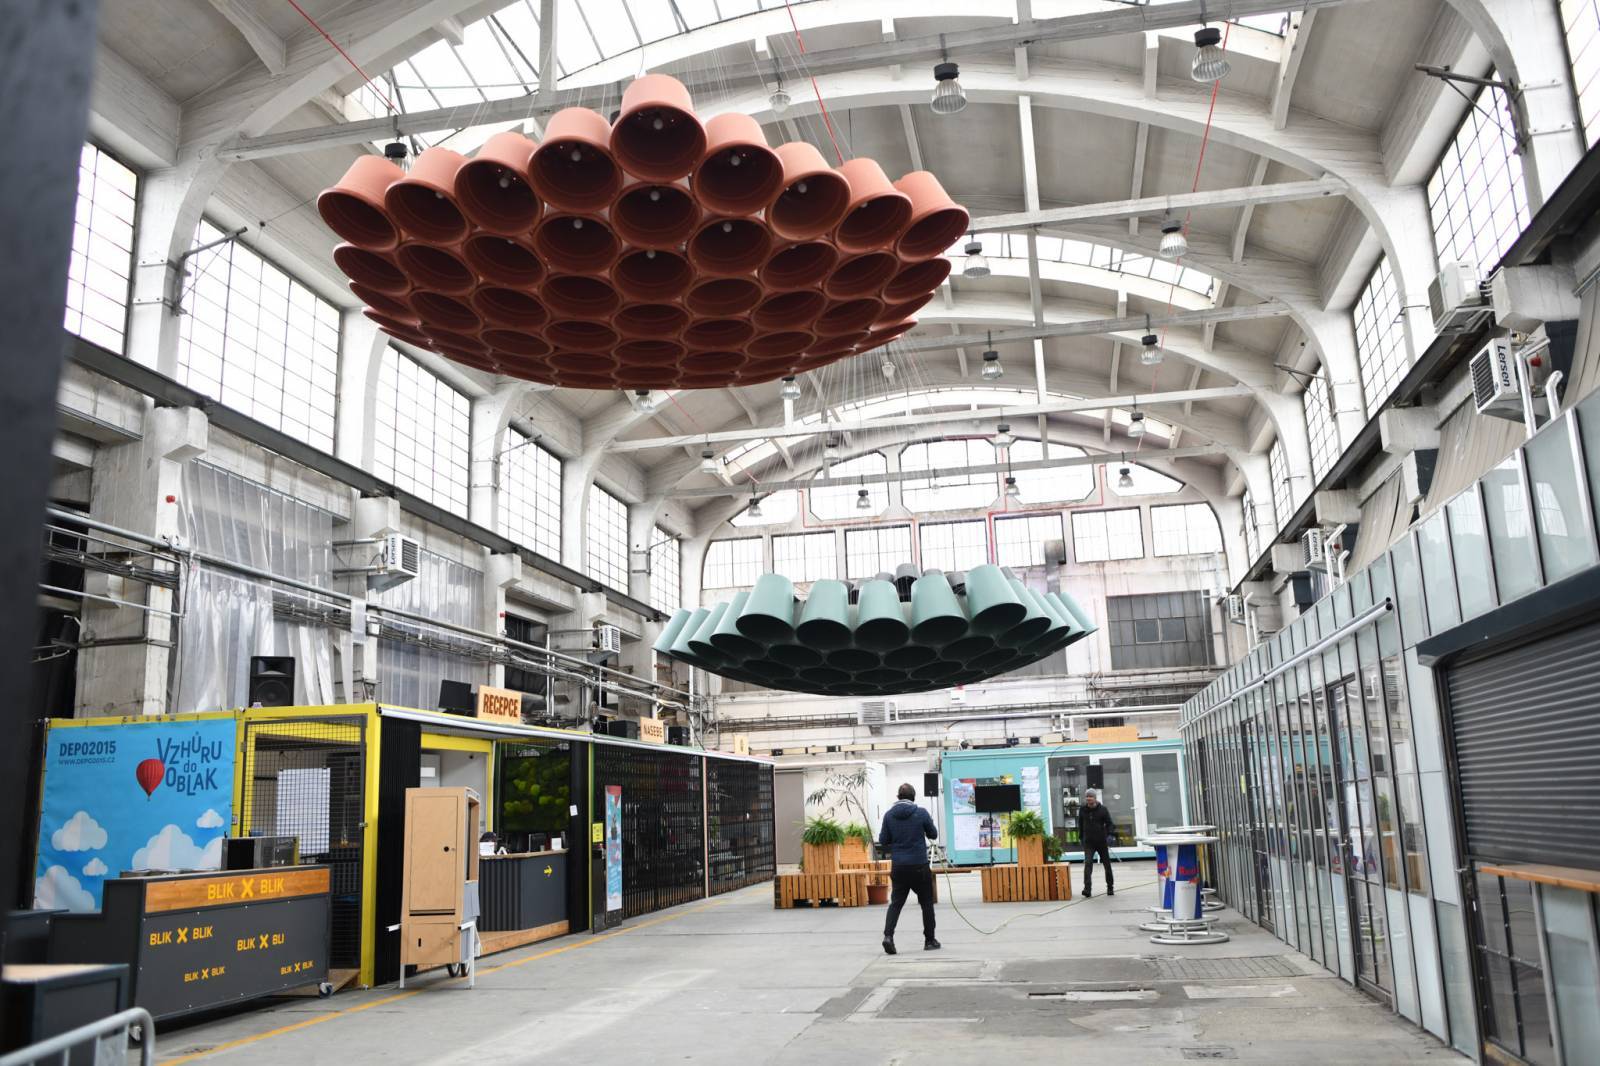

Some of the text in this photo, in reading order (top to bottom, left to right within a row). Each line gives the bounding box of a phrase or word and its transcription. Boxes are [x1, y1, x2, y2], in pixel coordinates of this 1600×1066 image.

[1497, 345, 1510, 387] Lersen
[482, 693, 518, 718] RECEPCE
[59, 741, 116, 757] DEPO2015
[156, 731, 222, 764] VZHŮRU
[183, 760, 197, 773] do
[165, 767, 218, 796] OBLAK
[207, 882, 234, 900] BLIK
[260, 878, 284, 894] BLIK
[150, 931, 172, 946] BLIK
[192, 926, 214, 940] BLIK
[236, 938, 256, 951] BLIK
[272, 933, 284, 945] BLI
[184, 972, 199, 982] BLIK
[211, 966, 225, 976] BLIK
[280, 965, 292, 975] BLIK
[302, 960, 314, 970] BLIK
